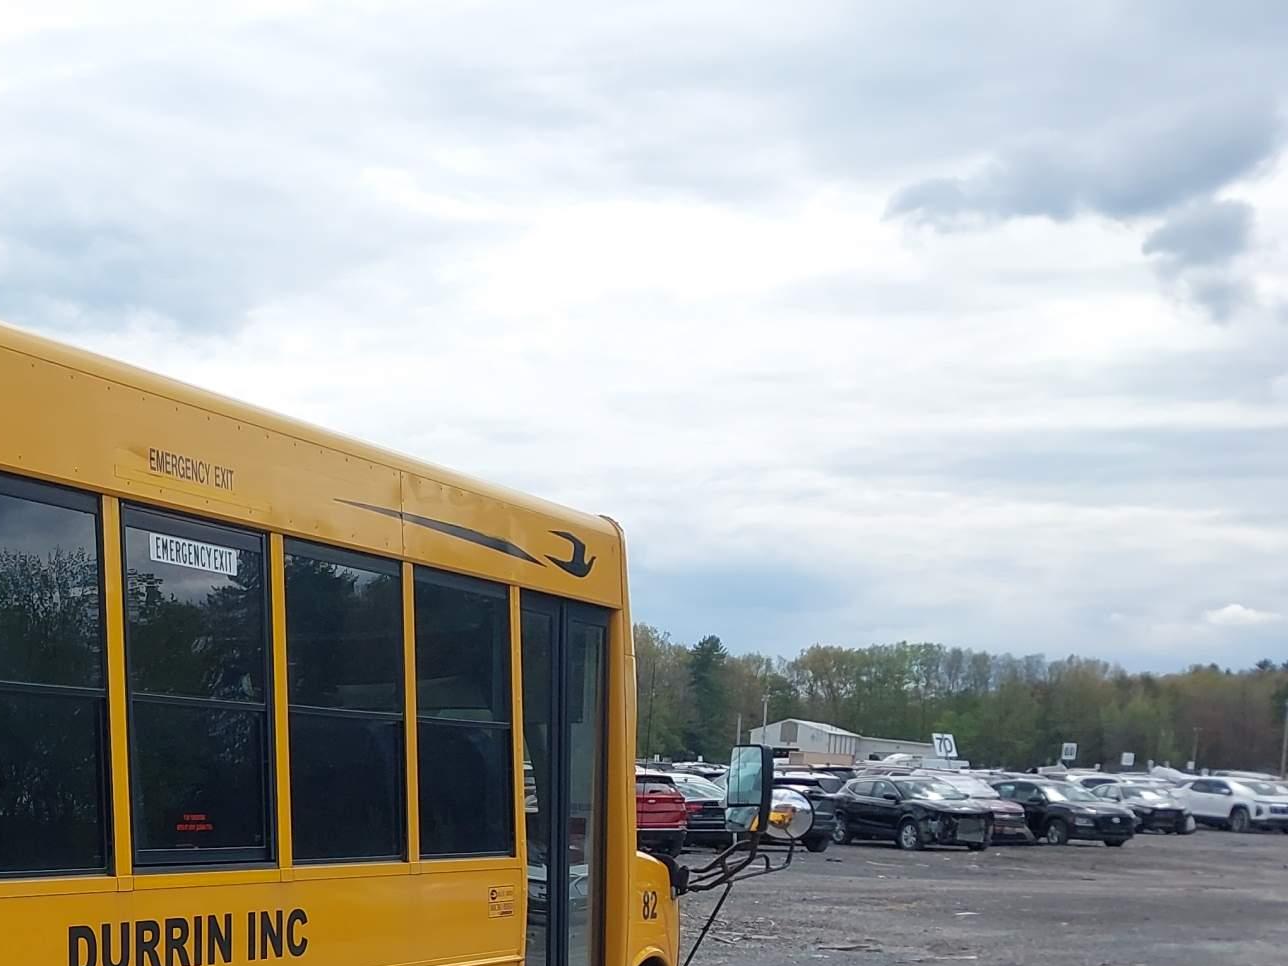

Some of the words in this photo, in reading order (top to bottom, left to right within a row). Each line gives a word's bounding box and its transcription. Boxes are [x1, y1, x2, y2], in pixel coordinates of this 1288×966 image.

[149, 448, 211, 485] EMERGENCY
[214, 465, 235, 491] EXIT
[155, 537, 212, 570] EMERGENCY
[213, 548, 233, 573] EXIT
[935, 736, 954, 753] 70
[642, 890, 658, 921] 82
[247, 908, 309, 961] INC
